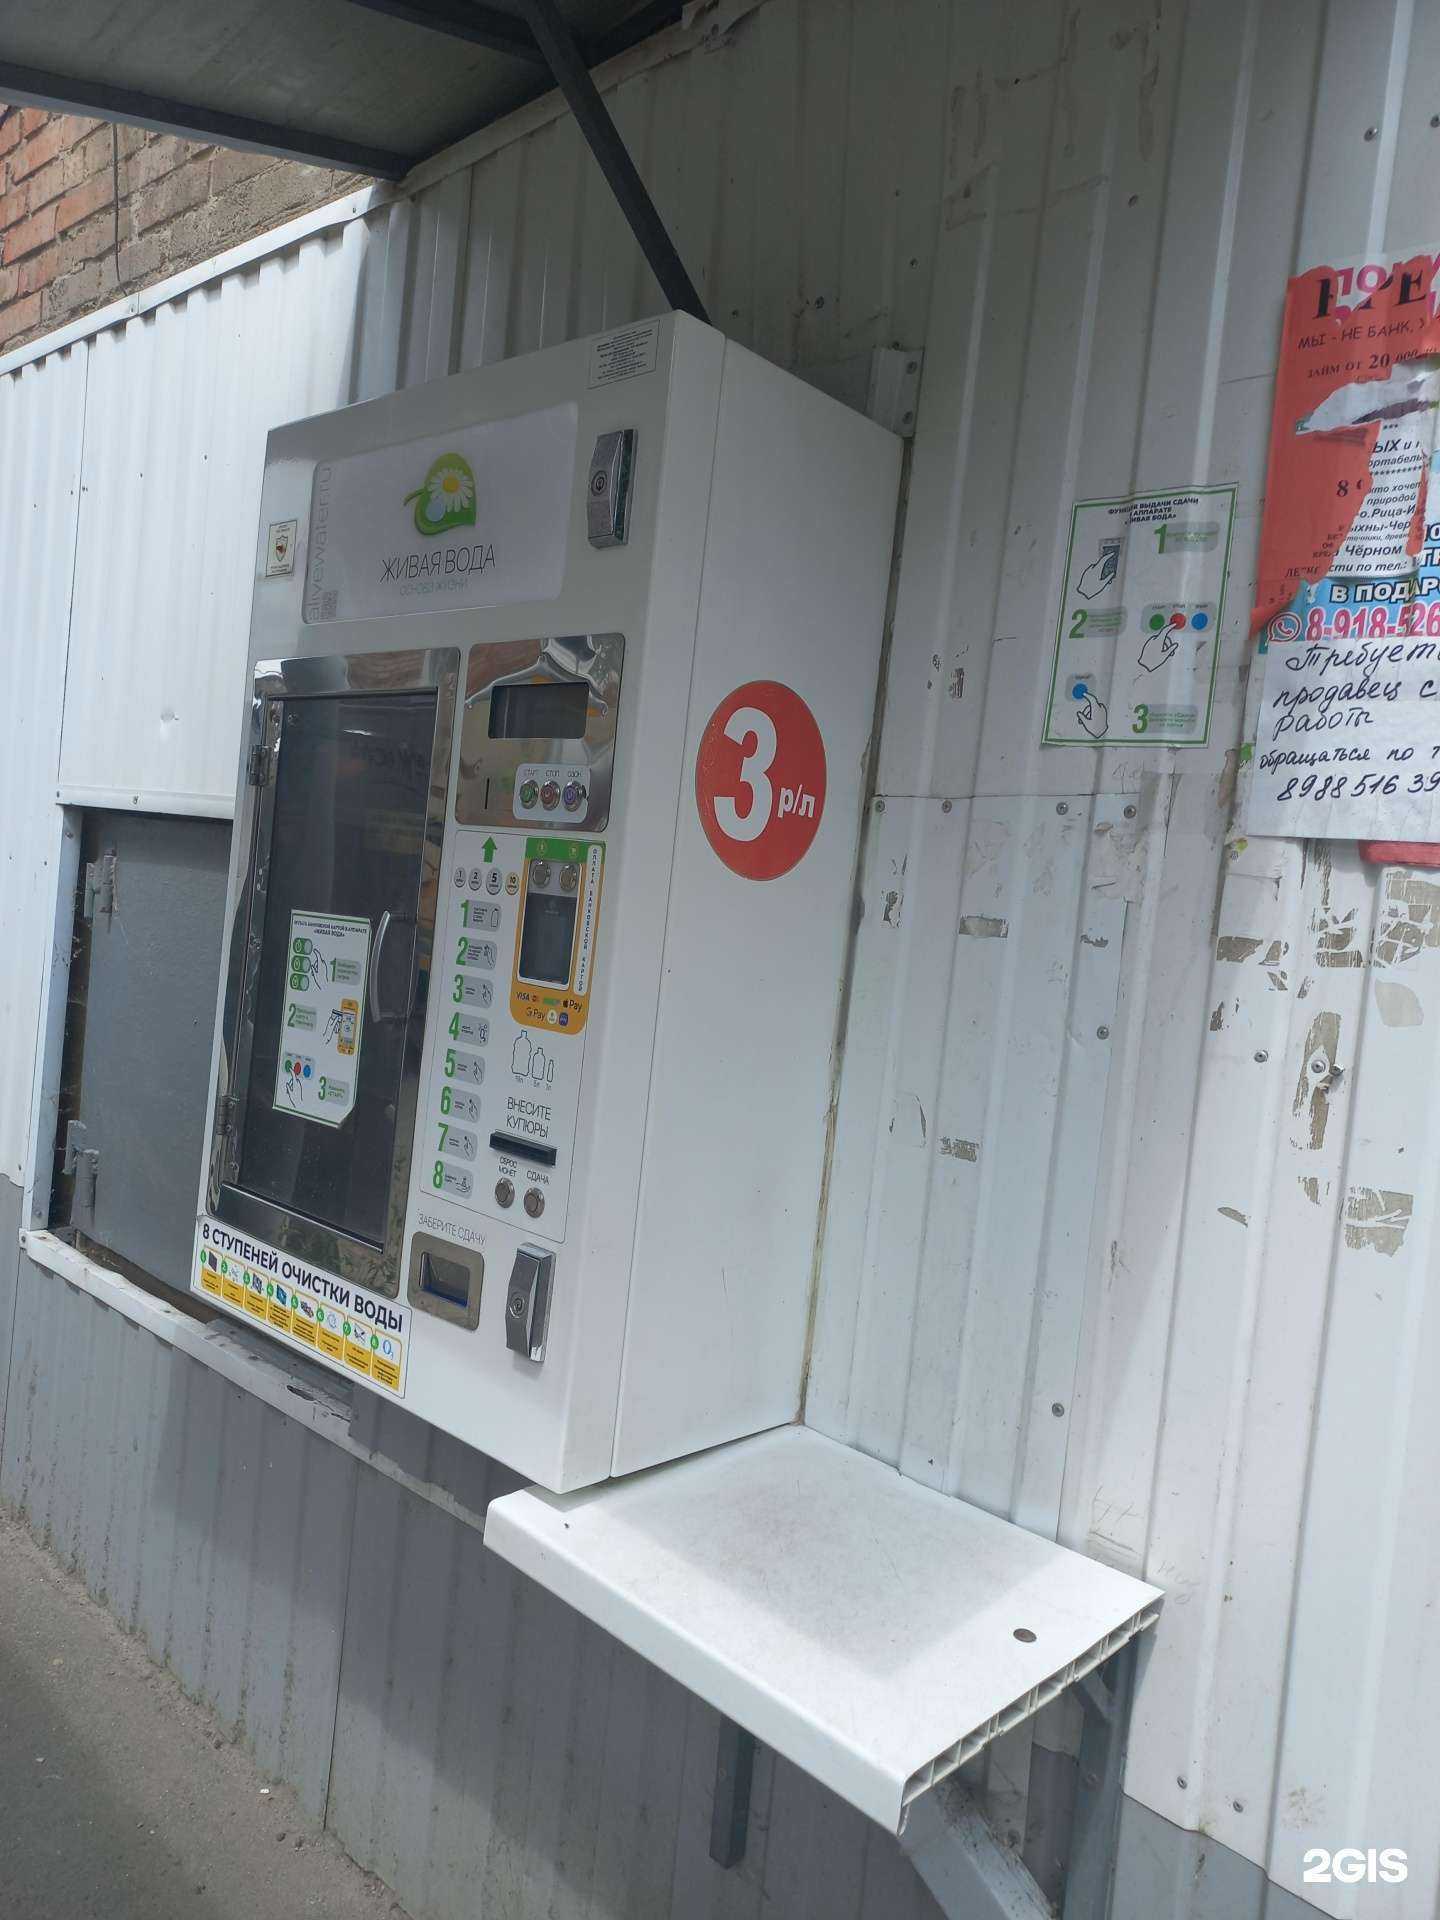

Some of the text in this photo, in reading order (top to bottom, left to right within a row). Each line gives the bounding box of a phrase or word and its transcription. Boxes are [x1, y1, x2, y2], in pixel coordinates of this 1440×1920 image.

[1297, 334, 1326, 350] МЫ
[1341, 326, 1361, 341] НЕ
[1369, 353, 1390, 369] 20
[1366, 492, 1417, 507] природой
[1154, 524, 1168, 554] 1
[1345, 545, 1402, 558] Чёрном
[380, 544, 496, 583] ЖИВАЯ ВОДА
[1356, 563, 1372, 572] по
[1330, 584, 1349, 603] В
[1069, 609, 1088, 639] 2
[1285, 642, 1440, 677] Требует
[1272, 677, 1402, 716] продавец
[1132, 704, 1148, 733] 3
[1272, 706, 1374, 741] работы
[713, 706, 816, 842] 3 р/л
[1259, 747, 1371, 775] обращаться
[1386, 747, 1414, 762] по
[1277, 774, 1348, 801] 8988
[1351, 773, 1399, 797] 516
[461, 899, 469, 928] 1
[456, 936, 468, 966] 2
[329, 957, 337, 982] 1
[453, 974, 464, 1003] 3
[516, 992, 583, 1013] VISA Pay
[287, 1003, 296, 1028] 2
[448, 1012, 460, 1041] 4
[533, 1008, 546, 1022] Pay
[444, 1048, 456, 1078] 5
[318, 1076, 327, 1100] 3
[440, 1086, 451, 1115] 6
[507, 1096, 551, 1121] ВНЕСИТЕ
[438, 1122, 449, 1151] 7
[507, 1115, 549, 1138] КУПЮРЫ
[433, 1160, 444, 1189] 8
[500, 1156, 517, 1168] СБРОС
[526, 1170, 550, 1185] СДАЧА
[418, 1213, 487, 1246] ЗАБЕРИТЕ СДАЧУ
[202, 1223, 210, 1239] 8
[212, 1230, 279, 1274] СТУПЕНЕЙ
[282, 1261, 350, 1309] ОЧИСТКИ
[354, 1292, 403, 1333] ВОДЫ
